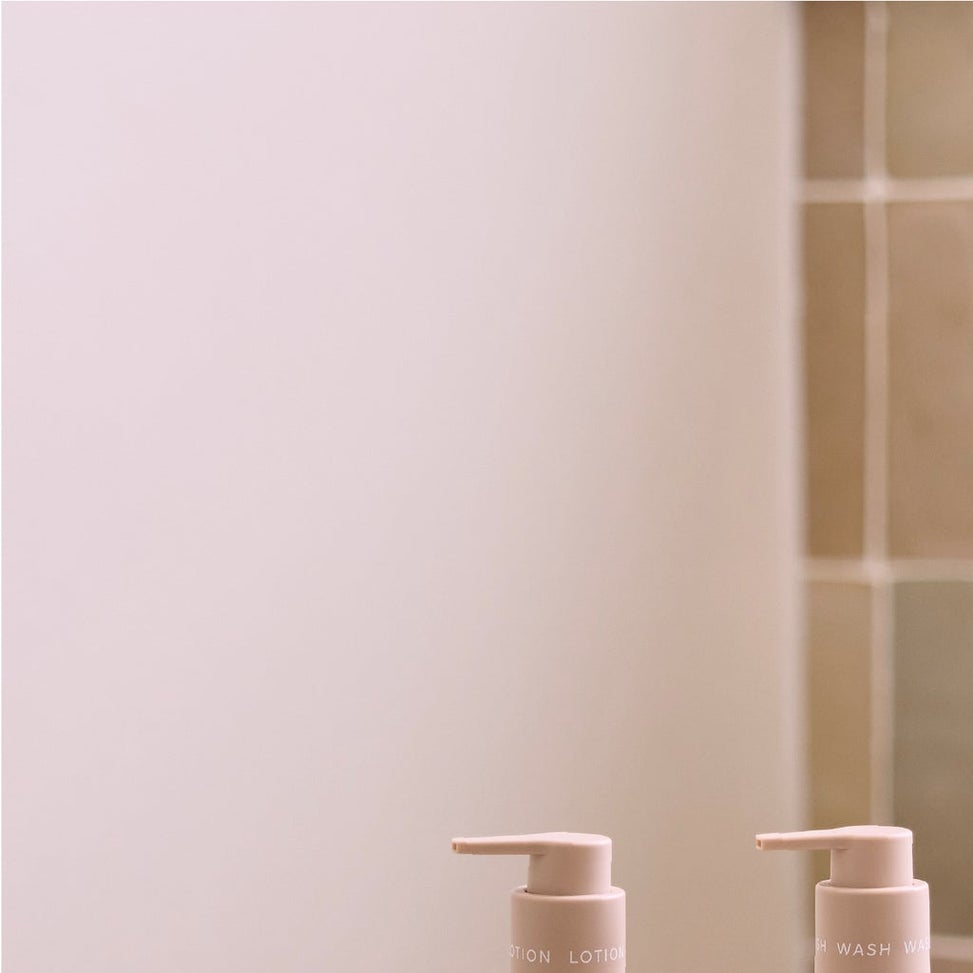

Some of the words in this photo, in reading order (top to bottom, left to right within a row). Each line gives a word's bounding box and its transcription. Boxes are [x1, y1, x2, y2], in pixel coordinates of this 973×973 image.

[510, 944, 551, 964] OTION
[569, 943, 625, 964] LOTION
[816, 938, 827, 953] SH
[836, 942, 891, 957] WASH
[903, 936, 930, 954] WAS
